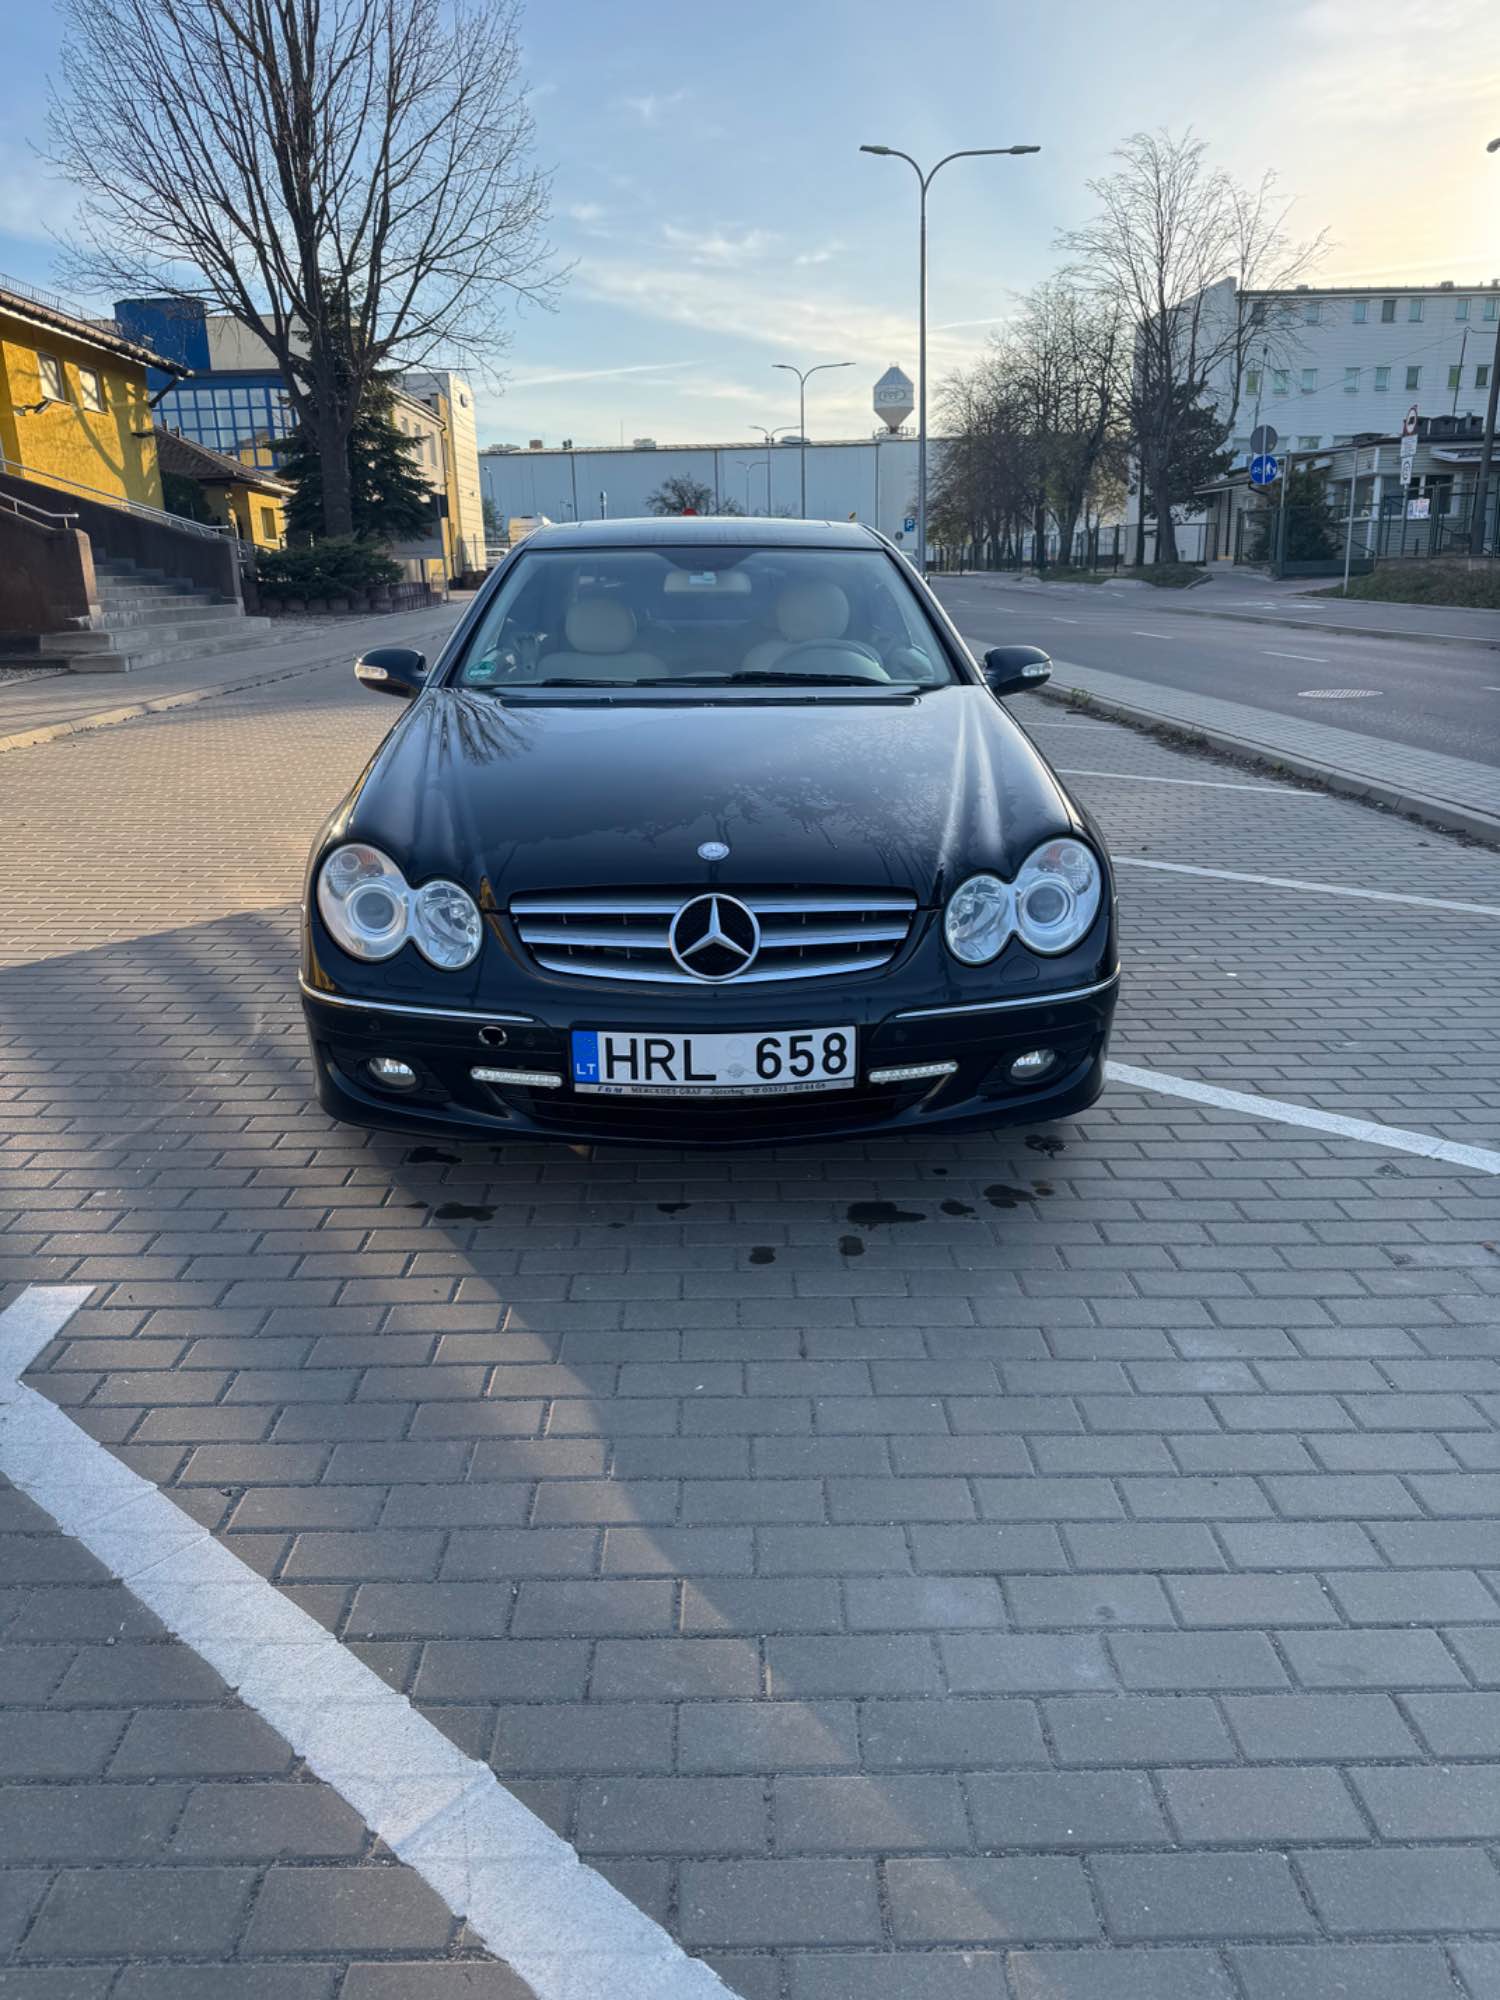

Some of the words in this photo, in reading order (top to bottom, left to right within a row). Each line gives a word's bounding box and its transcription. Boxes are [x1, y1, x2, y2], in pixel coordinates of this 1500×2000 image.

[576, 1063, 596, 1076] LT
[605, 1037, 717, 1081] HRL
[755, 1032, 848, 1079] 658
